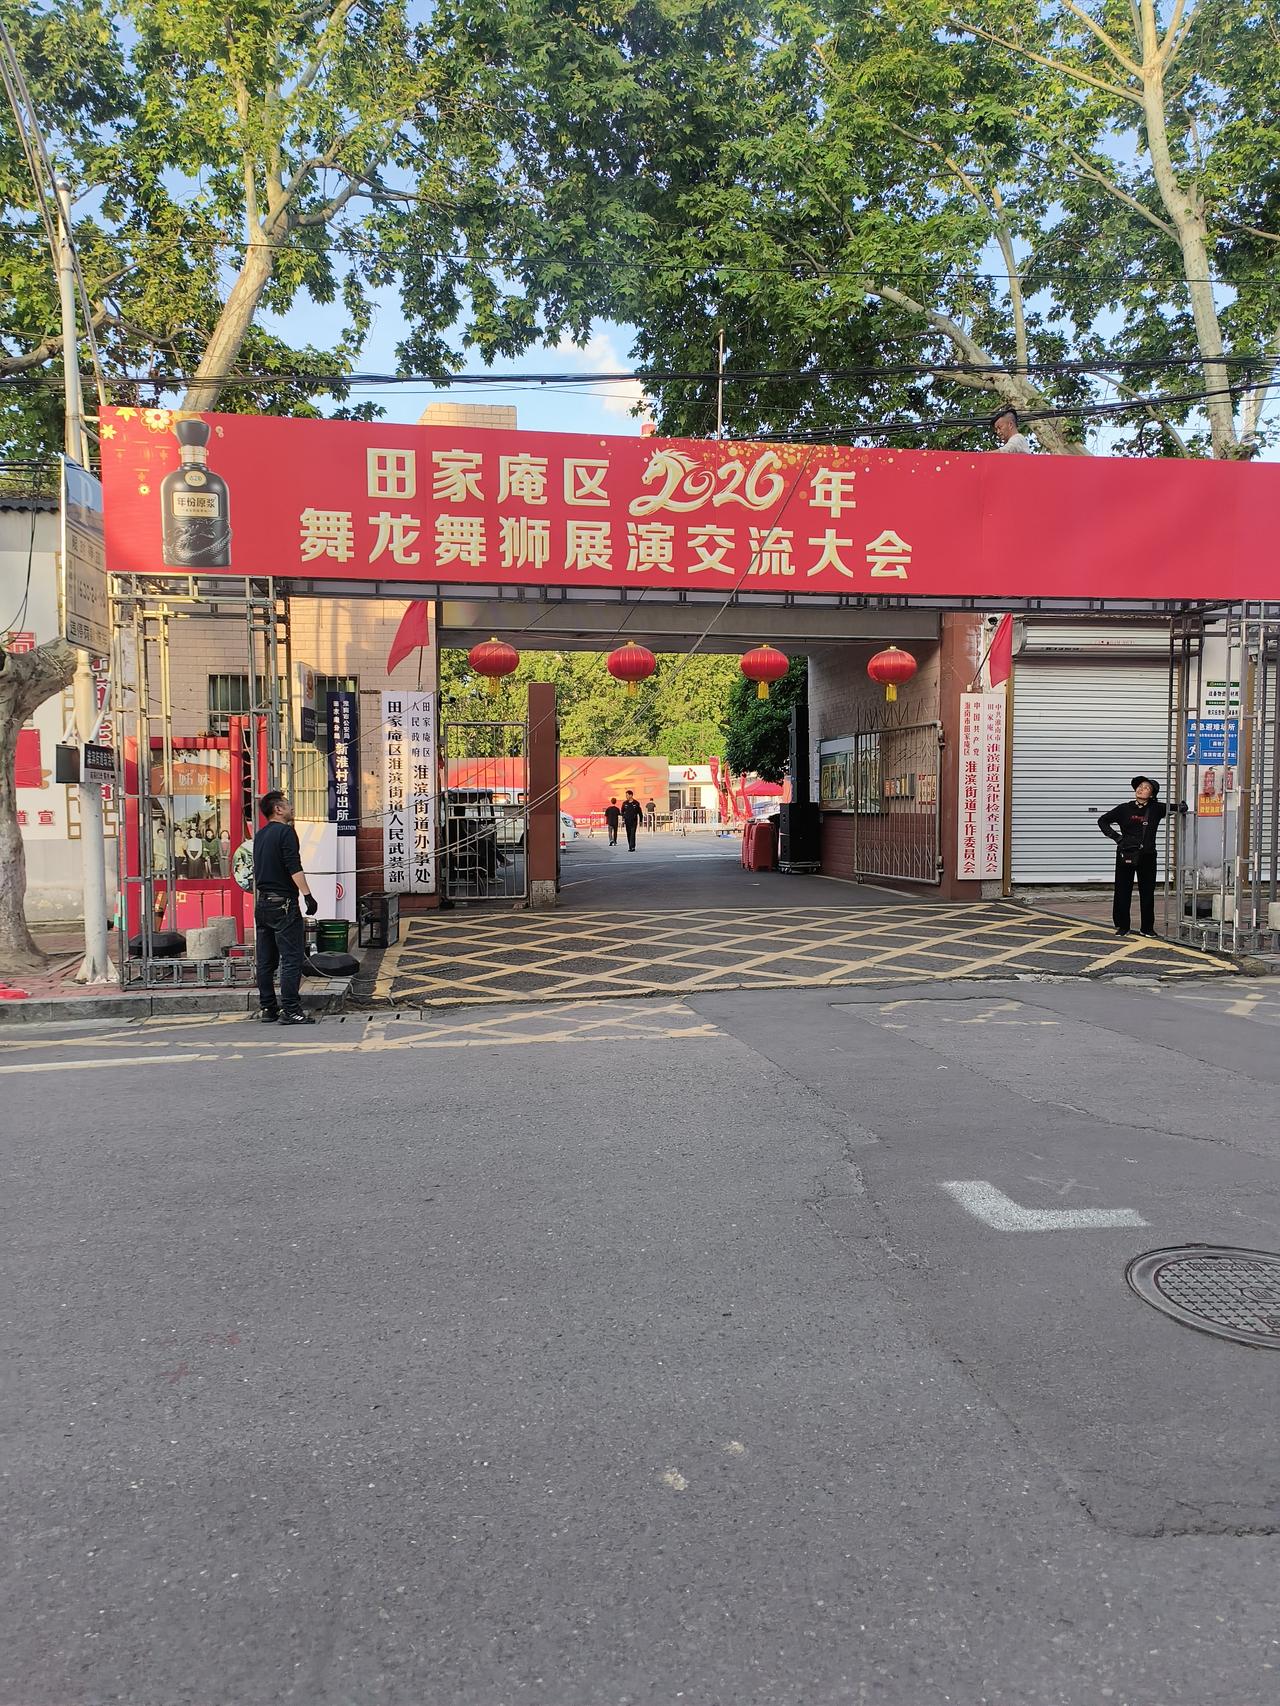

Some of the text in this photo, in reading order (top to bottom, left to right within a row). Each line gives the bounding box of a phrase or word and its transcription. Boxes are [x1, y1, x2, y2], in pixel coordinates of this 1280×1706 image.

[177, 496, 216, 508] 年份原浆
[300, 507, 913, 580] 舞龙舞狮展演交流大会
[411, 701, 420, 758] 人民政府
[422, 701, 431, 758] 田家庵区
[973, 701, 981, 757] 中国共产党
[335, 742, 350, 821] 新淮村派出所
[387, 700, 404, 883] 田家庵区淮滨街道人民武装部
[683, 767, 697, 781] 心
[986, 743, 1000, 873] 淮滨街道纪律检查工作委员会
[413, 764, 431, 884] 淮滨街道办事处
[963, 760, 978, 874] 淮滨街道工作委员会
